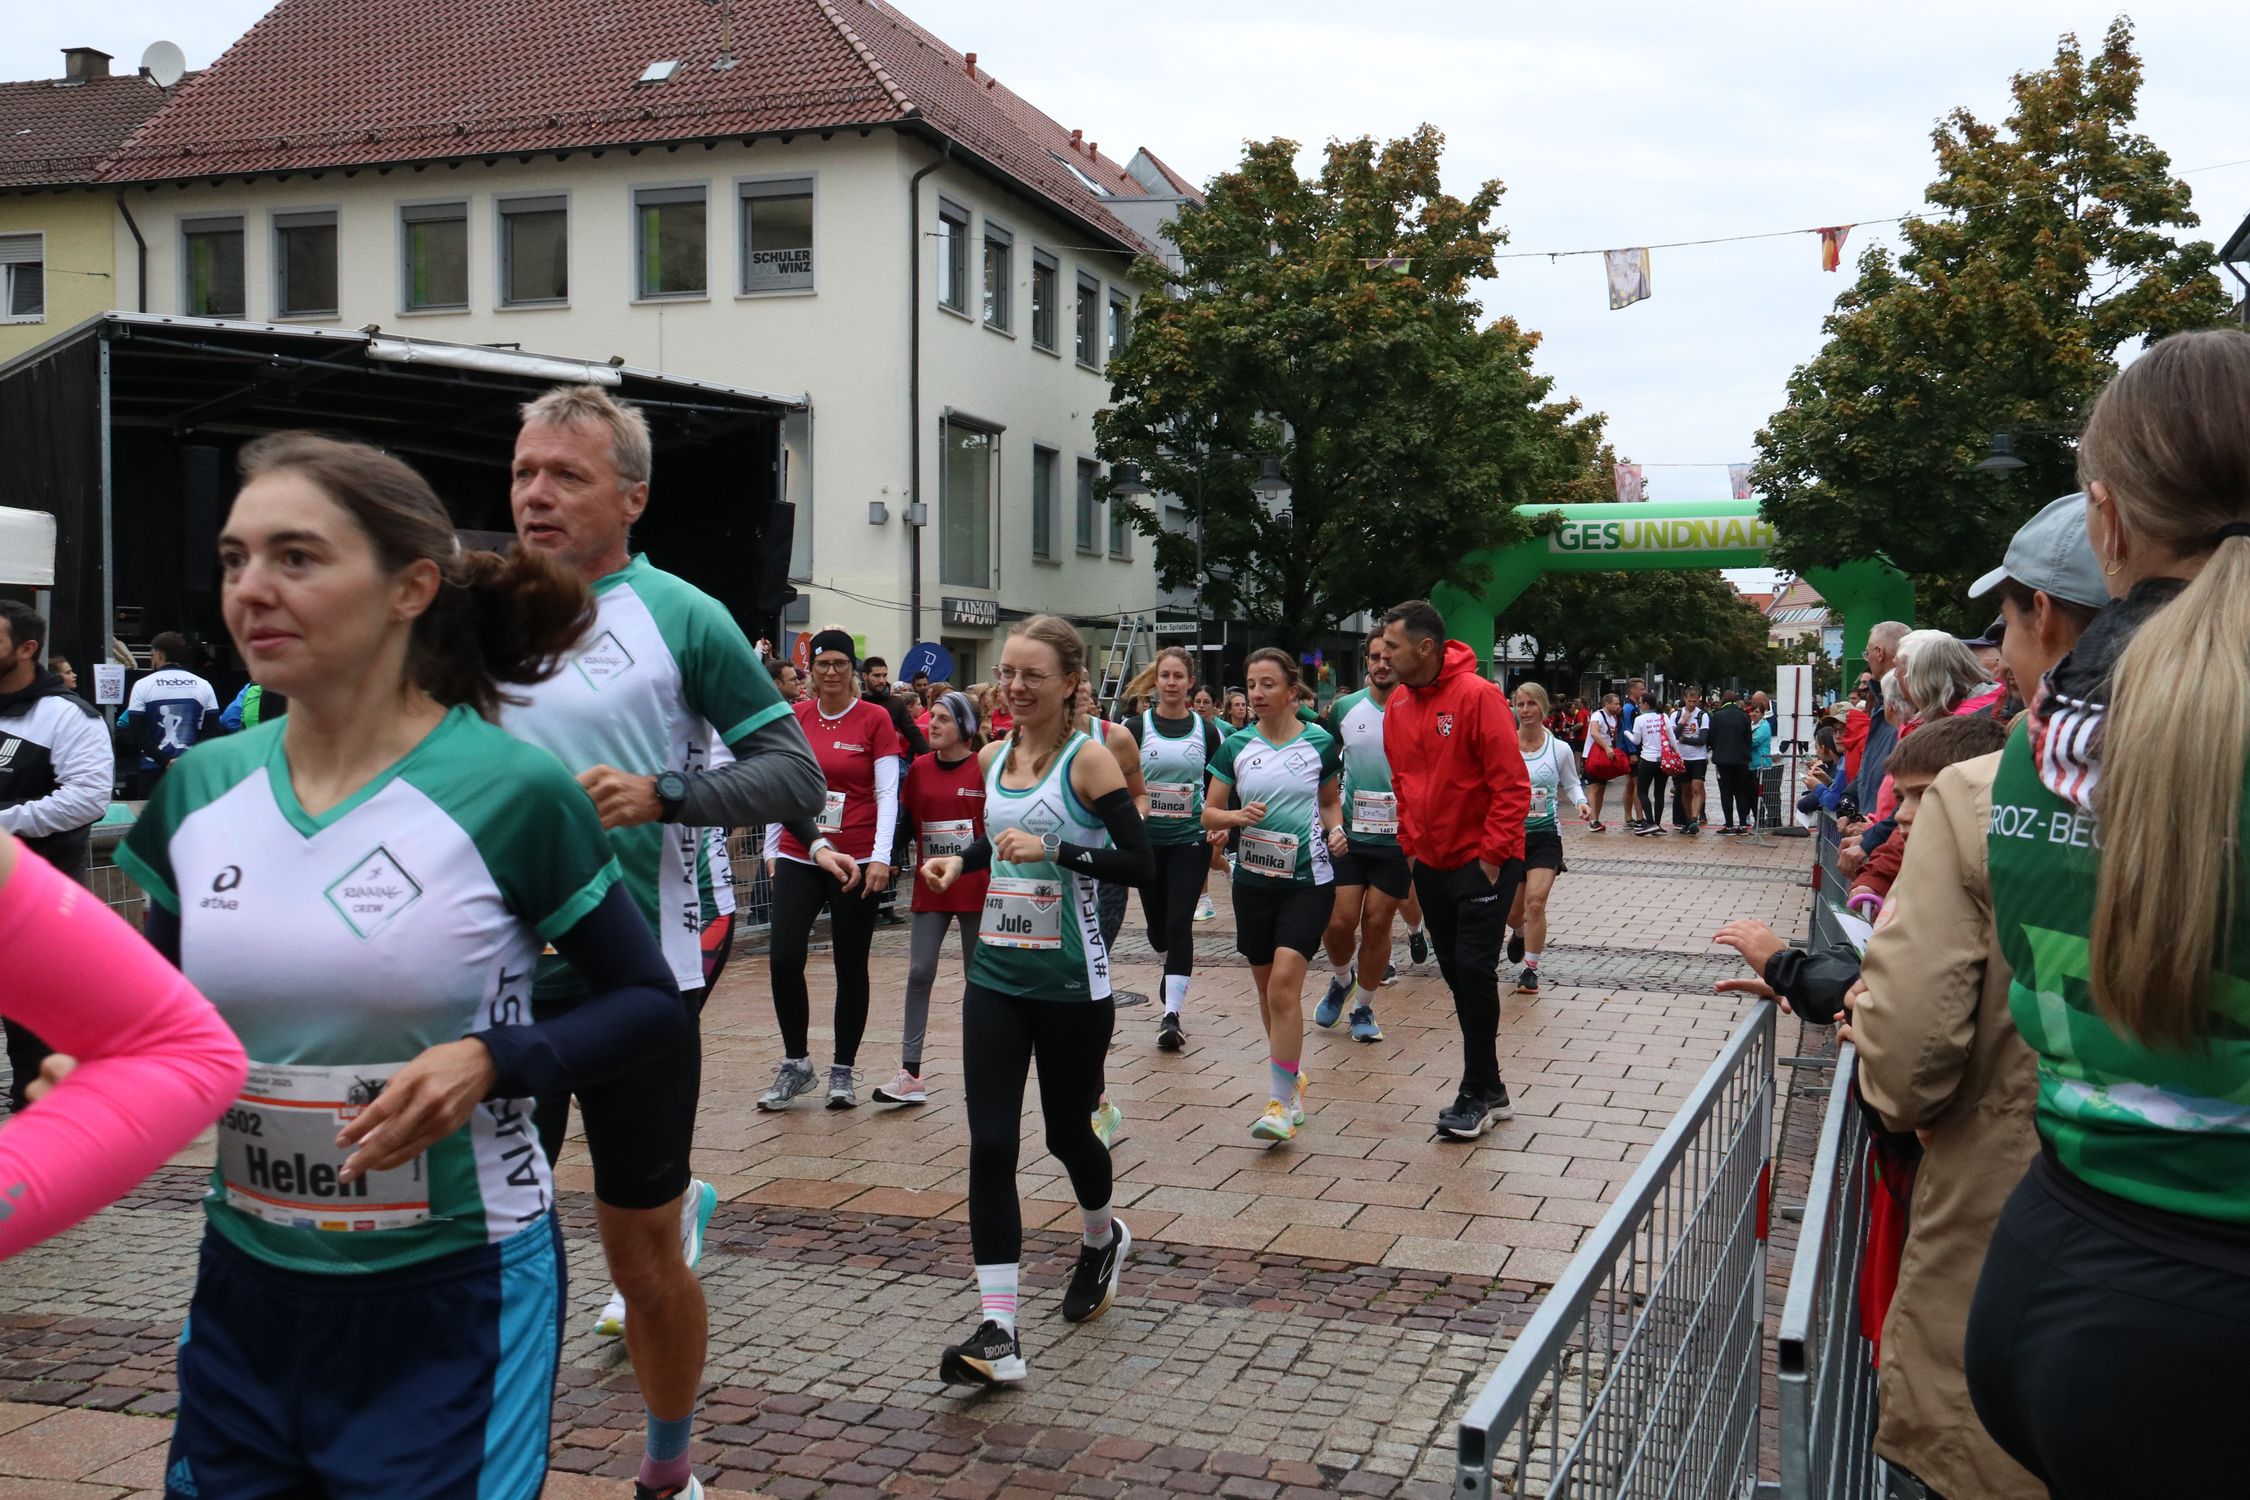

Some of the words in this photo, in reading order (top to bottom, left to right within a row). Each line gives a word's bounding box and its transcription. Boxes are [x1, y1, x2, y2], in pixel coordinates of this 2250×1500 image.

[752, 250, 811, 264] SCHULER
[778, 262, 811, 273] WINZ
[1556, 519, 1774, 550] GESUNDNAH
[953, 600, 997, 624] MADISON
[156, 679, 198, 687] theben
[1151, 800, 1185, 811] Bianca
[930, 843, 961, 855] Marie
[1241, 839, 1256, 849] 1471
[1244, 850, 1285, 869] Annika
[352, 904, 384, 913] CREW
[985, 898, 1003, 909] 1478
[996, 913, 1032, 934] Jule
[246, 1145, 368, 1198] Helen
[984, 1342, 1016, 1359] BROOKS
